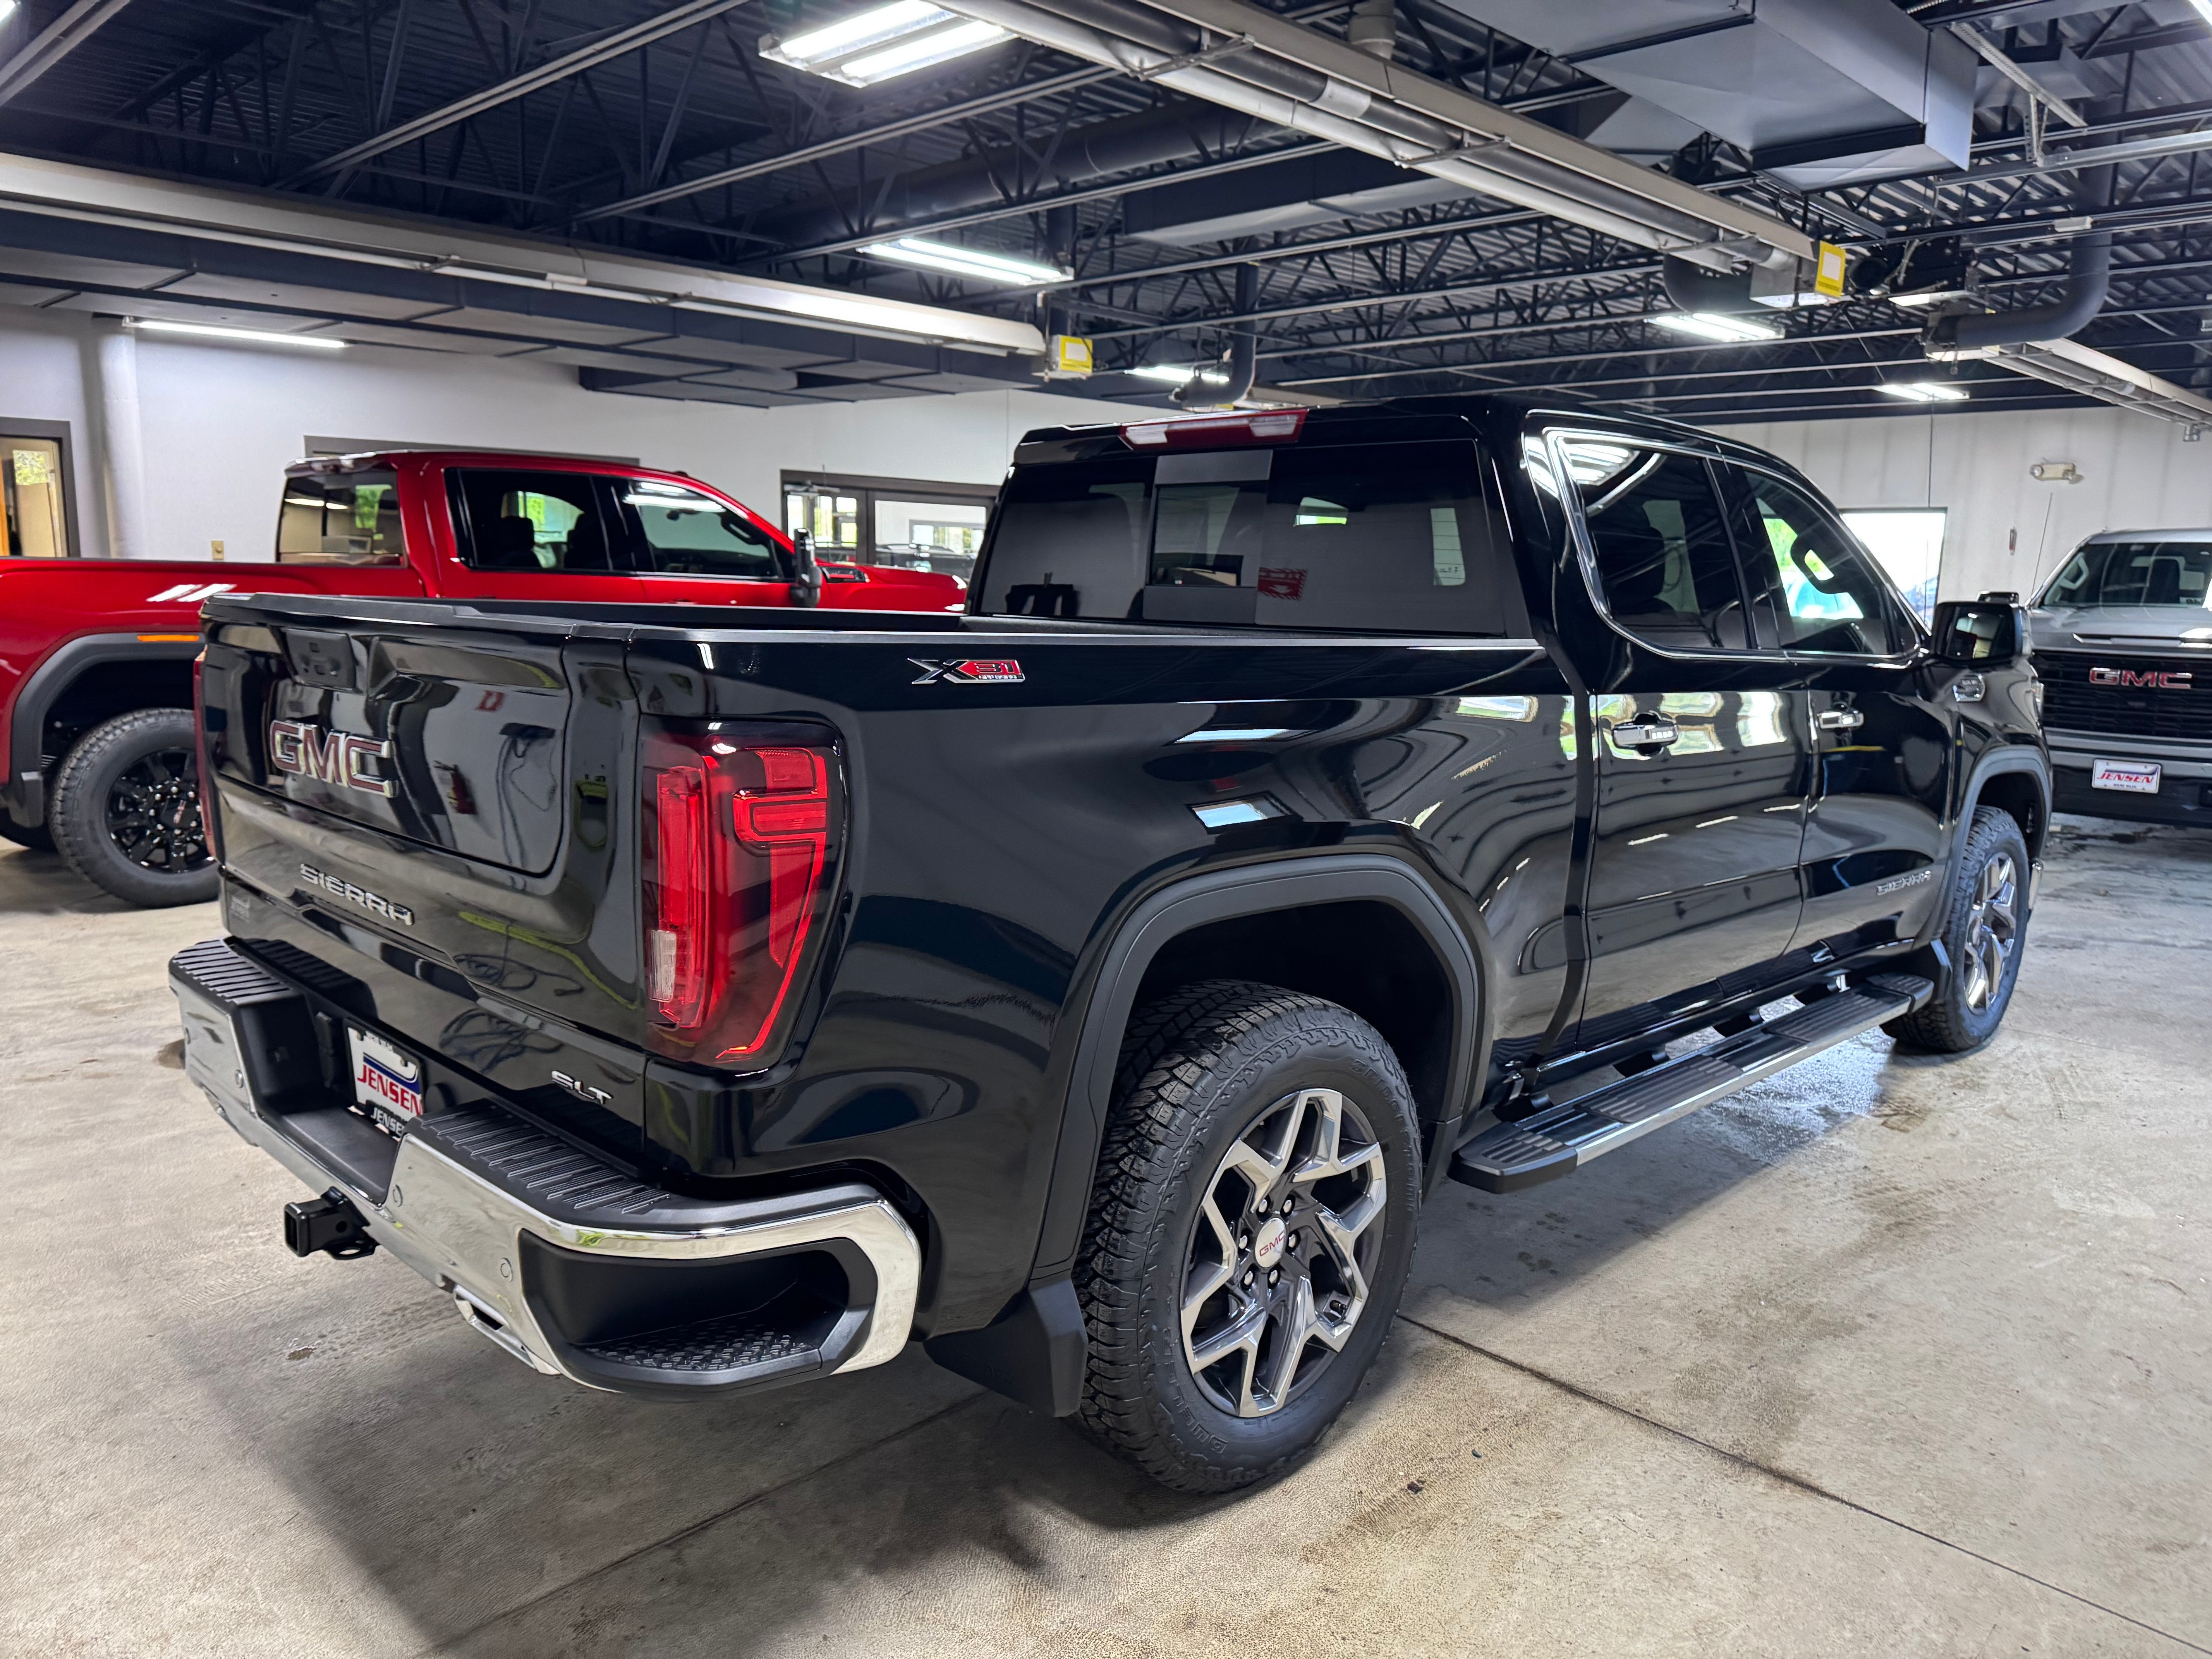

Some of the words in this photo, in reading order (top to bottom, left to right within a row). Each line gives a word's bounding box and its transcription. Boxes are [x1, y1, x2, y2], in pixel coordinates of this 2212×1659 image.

[2089, 667, 2193, 689] GMC
[271, 720, 399, 799] GMC
[2097, 772, 2154, 784] JENSEN
[300, 863, 414, 926] SIERRA
[1876, 870, 1931, 896] SIERRA
[357, 1064, 423, 1116] JENSEN
[551, 1070, 614, 1105] SLT
[370, 1107, 405, 1137] JENSE
[1259, 1230, 1285, 1257] GMC
